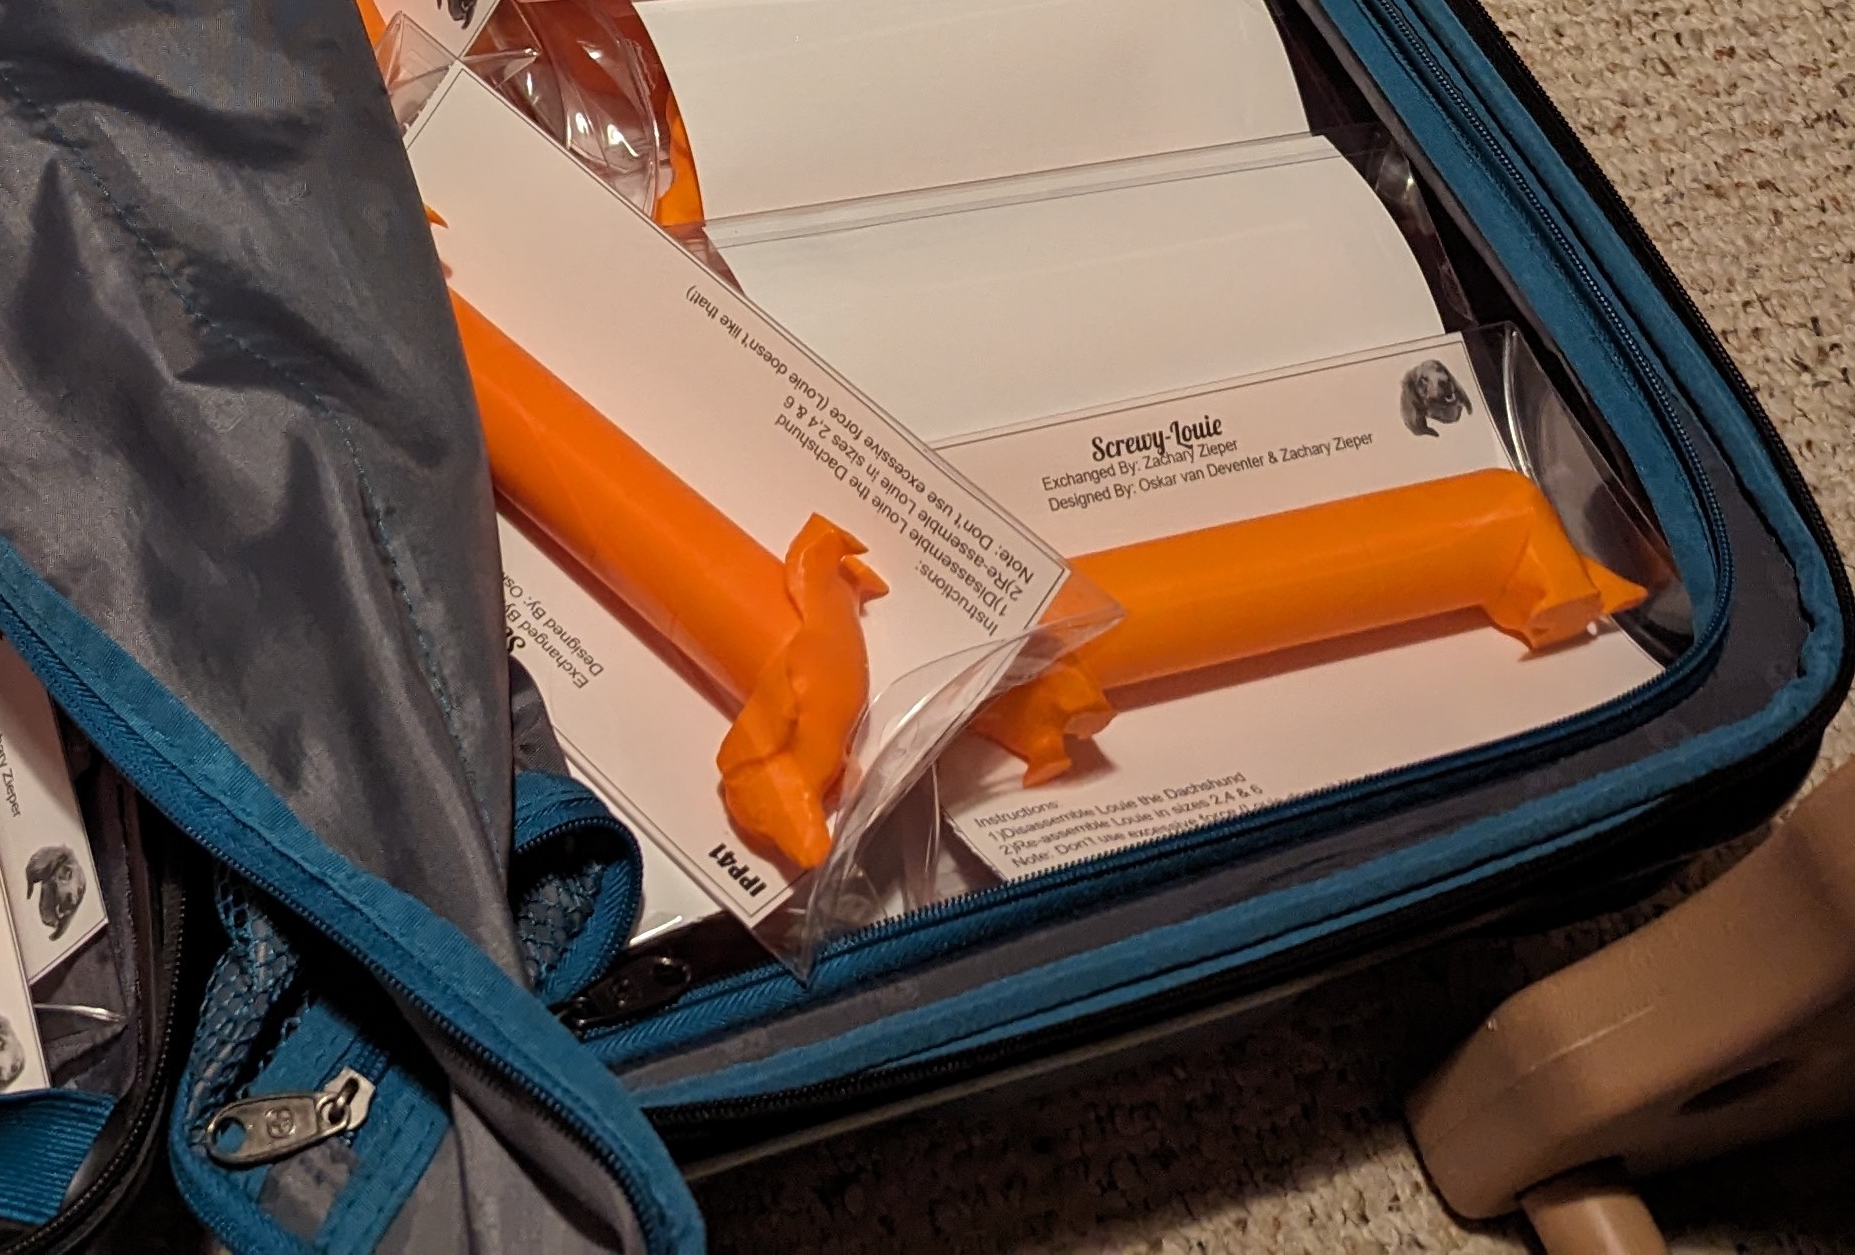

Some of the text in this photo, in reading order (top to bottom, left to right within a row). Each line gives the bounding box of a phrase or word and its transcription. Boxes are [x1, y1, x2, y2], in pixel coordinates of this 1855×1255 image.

[685, 285, 1035, 585] Note: Don't use excessive force (Louie doesn't like that!)
[1041, 440, 1238, 492] Exchanged By: Zachary Zieper
[1047, 433, 1373, 512] Designed By: Oskar van Deventer & Zachary Zieper
[1089, 414, 1222, 462] Screwy-Louie
[774, 413, 1008, 617] 1)Disassemble Louie the Dachshund
[783, 395, 1023, 602] 2)Re-assemble Louie in sizes 2,4 & 6
[523, 596, 604, 677] Designed By:
[915, 560, 999, 637] Instructions:
[517, 620, 589, 689] Exchanged
[708, 843, 767, 898] IPP41
